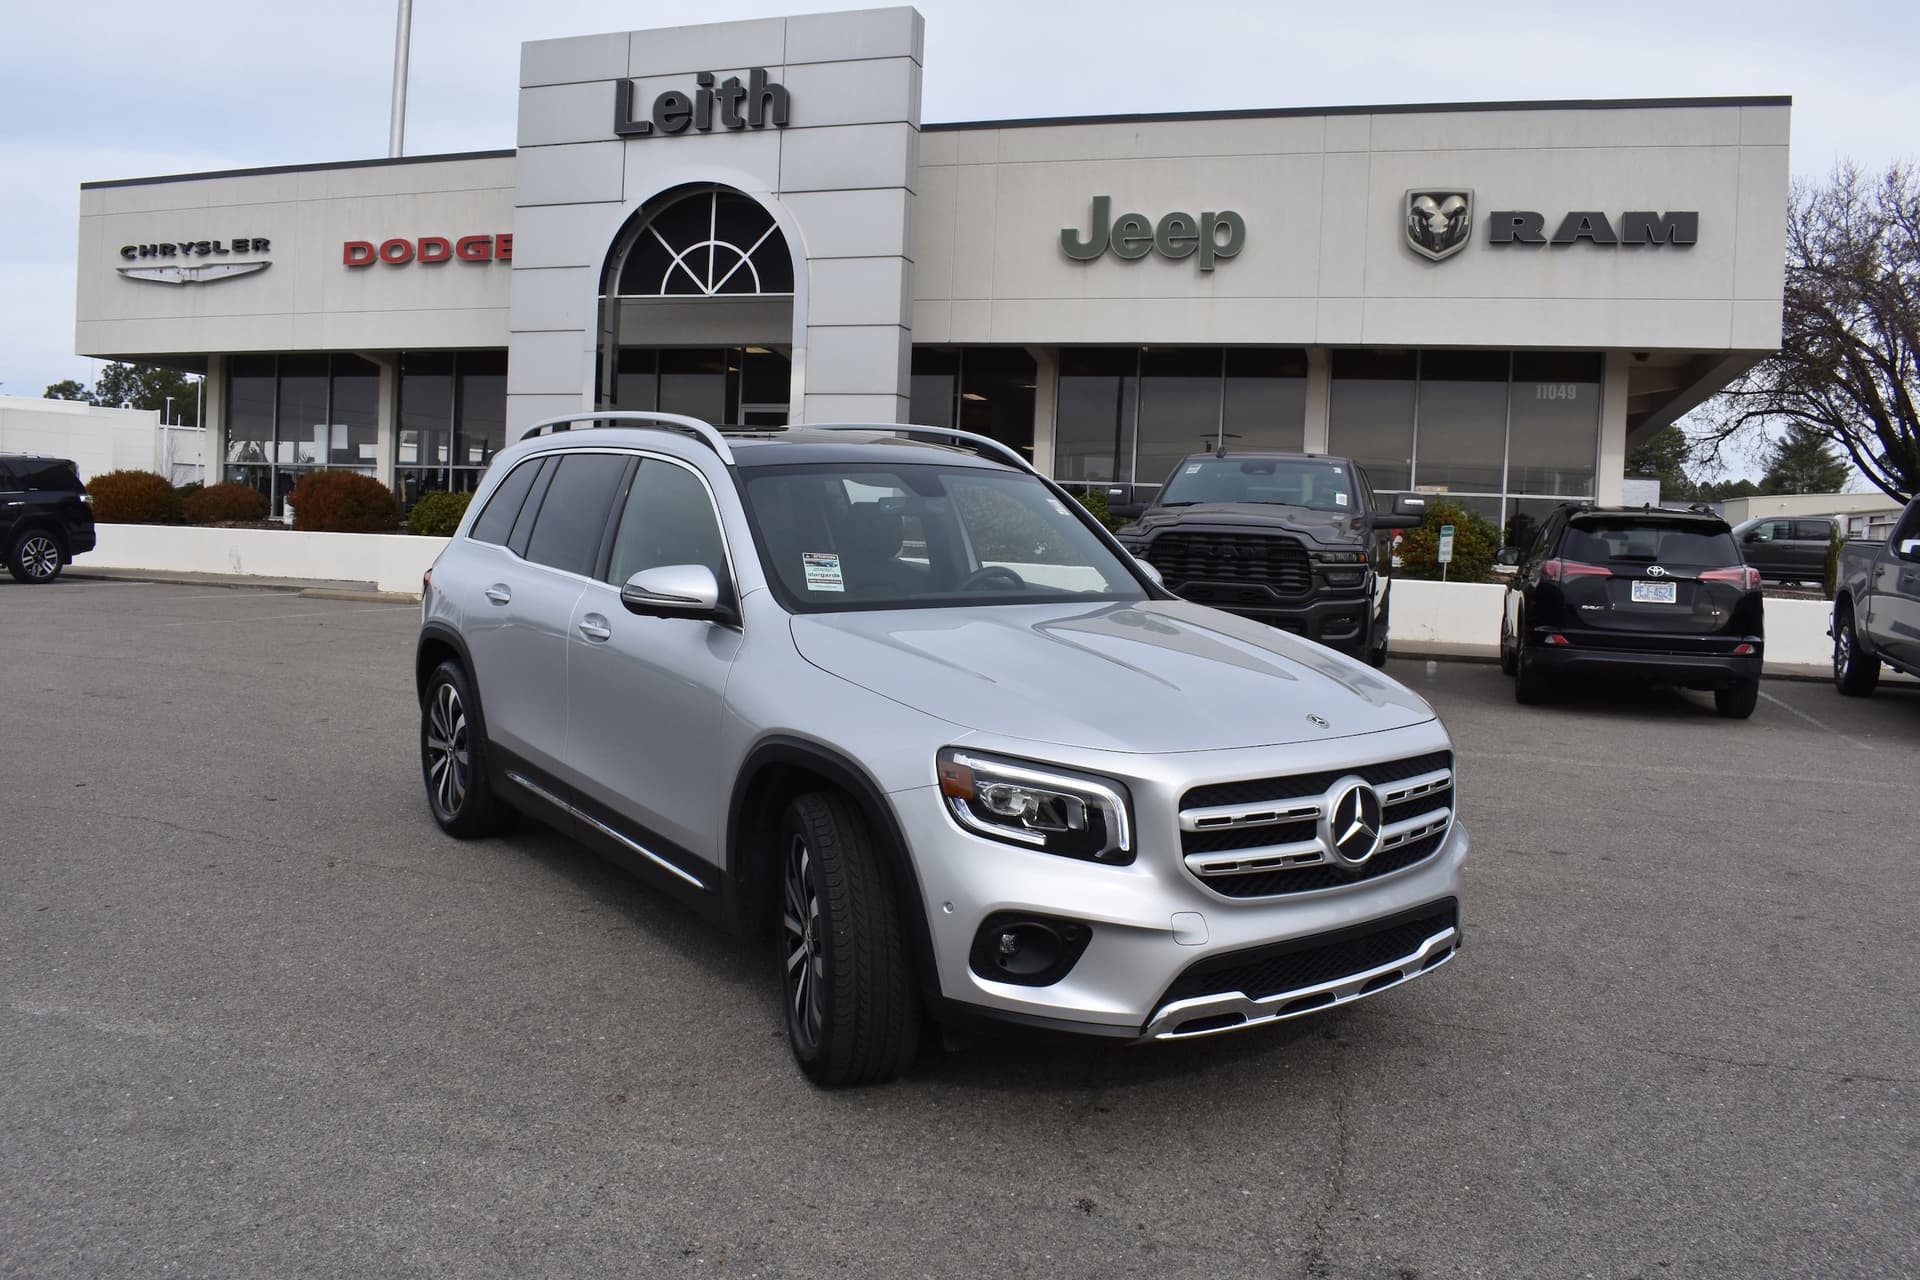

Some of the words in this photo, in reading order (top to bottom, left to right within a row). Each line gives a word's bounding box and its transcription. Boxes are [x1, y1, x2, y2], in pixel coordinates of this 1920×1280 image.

[614, 67, 790, 137] Leith
[1060, 195, 1246, 272] Jeep
[1489, 211, 1699, 246] RAM
[120, 237, 271, 259] CHRYSLER
[343, 233, 513, 267] DODGE
[1535, 384, 1577, 400] 11049
